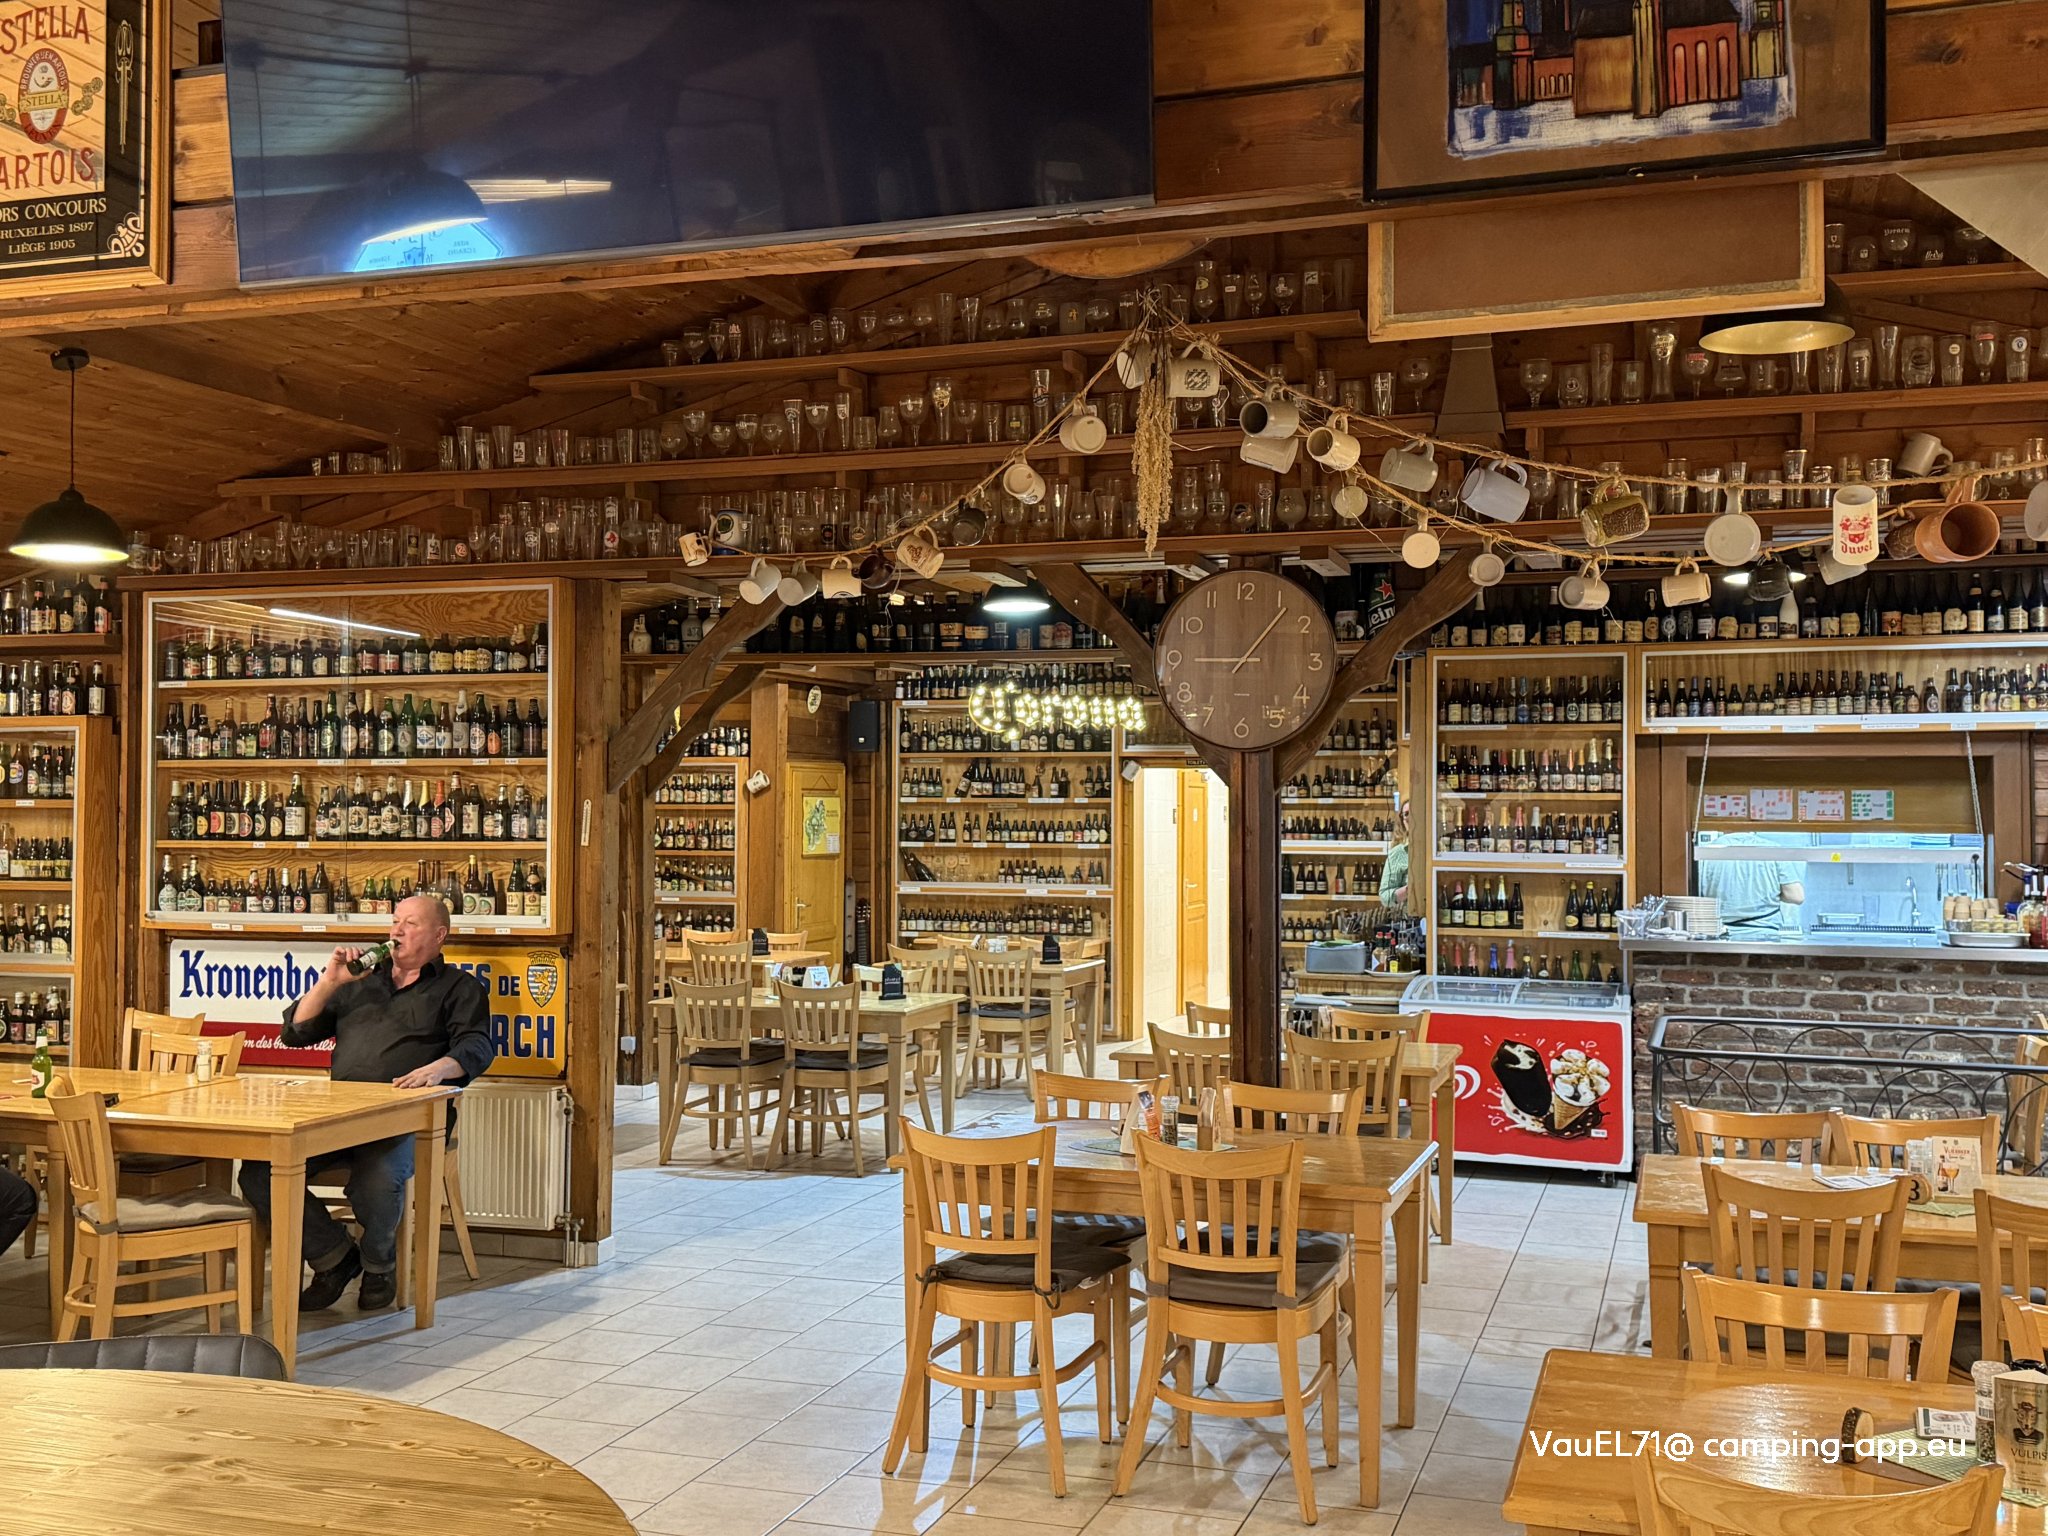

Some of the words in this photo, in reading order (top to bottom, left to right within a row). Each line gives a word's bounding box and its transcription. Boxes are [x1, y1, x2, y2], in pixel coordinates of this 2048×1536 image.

[0, 5, 90, 54] STELLA
[25, 94, 64, 107] STELLA
[0, 147, 94, 190] ARTOIS
[0, 206, 19, 223] RS
[25, 198, 106, 220] CONCOURS
[0, 224, 64, 239] RUXELLES
[69, 222, 94, 233] 1897
[8, 242, 46, 255] LIÈGE
[49, 240, 76, 251] 1905
[1840, 540, 1872, 554] duvel
[1206, 590, 1217, 608] 11
[1237, 582, 1255, 600] 12
[1277, 590, 1282, 608] 1
[1180, 616, 1203, 634] 10
[1297, 615, 1311, 633] 2
[1368, 606, 1396, 628] ein
[1166, 650, 1182, 671] 9
[1308, 653, 1323, 671] 3
[1177, 682, 1192, 703] 8
[1293, 684, 1310, 704] 4
[969, 681, 1147, 743] Corona
[1203, 706, 1215, 727] 7
[1268, 709, 1284, 728] 5
[1234, 717, 1249, 738] 6
[179, 949, 327, 1001] Kronenbo
[498, 975, 520, 996] DE
[256, 1035, 273, 1049] des
[491, 1014, 555, 1058] RCH
[1908, 1179, 1920, 1201] 3
